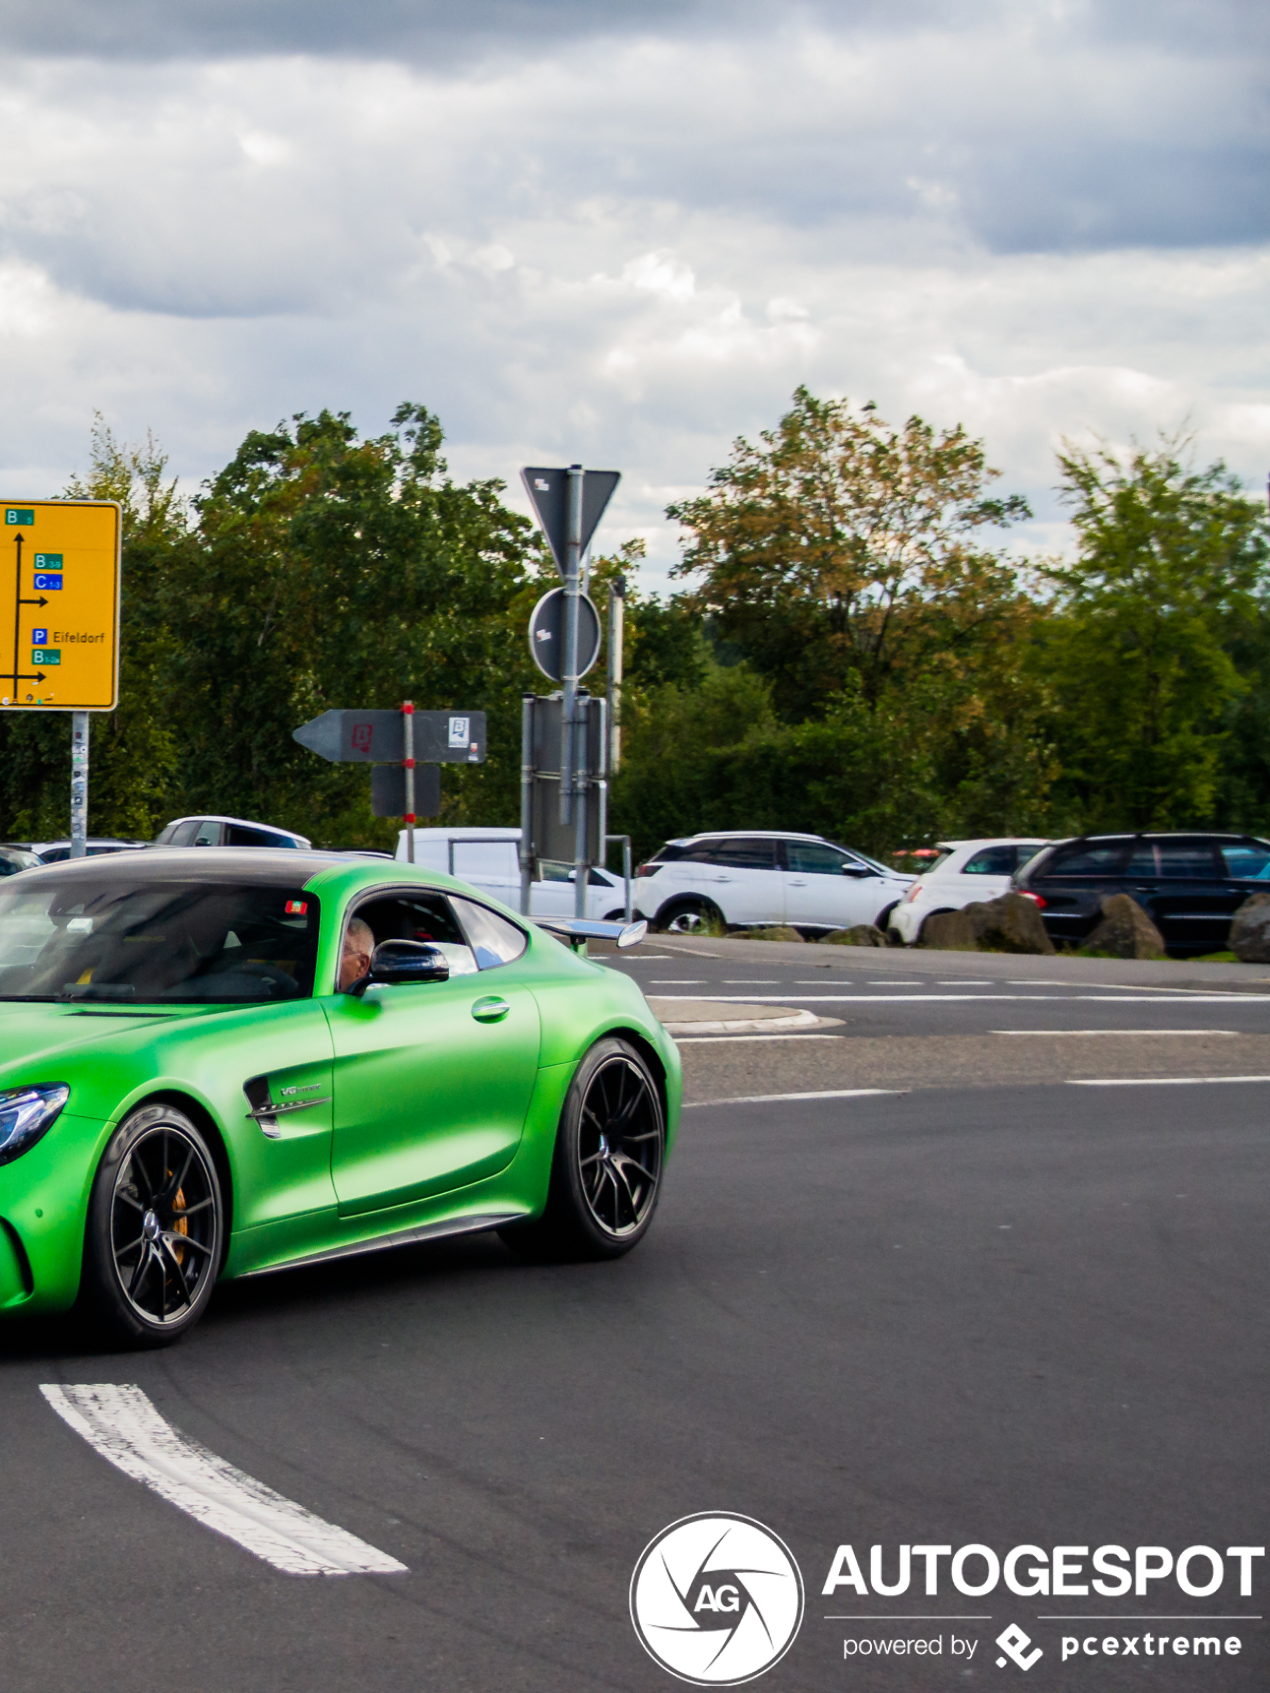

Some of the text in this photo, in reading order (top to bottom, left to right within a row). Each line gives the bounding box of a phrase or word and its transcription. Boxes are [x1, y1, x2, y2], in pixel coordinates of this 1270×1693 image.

[8, 511, 18, 524] B
[36, 555, 46, 568] B
[35, 575, 47, 589] C
[53, 631, 105, 644] Eifeldorf
[33, 650, 44, 664] B
